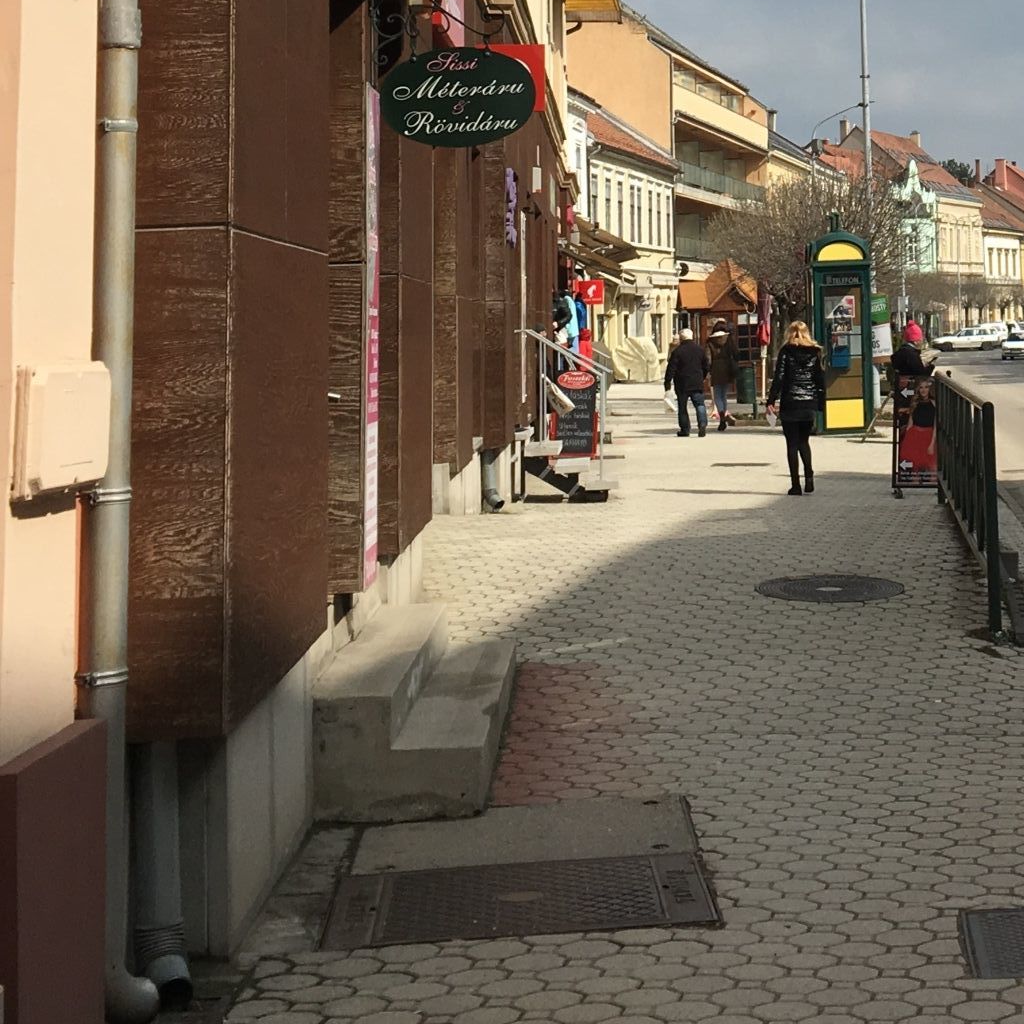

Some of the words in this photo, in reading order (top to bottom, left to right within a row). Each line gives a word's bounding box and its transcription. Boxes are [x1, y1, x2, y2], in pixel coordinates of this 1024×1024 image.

[426, 51, 478, 73] Sissi
[392, 75, 525, 101] Méteráru
[452, 99, 471, 115] &
[403, 110, 518, 136] Rövidáru
[832, 276, 859, 284] TELEFON
